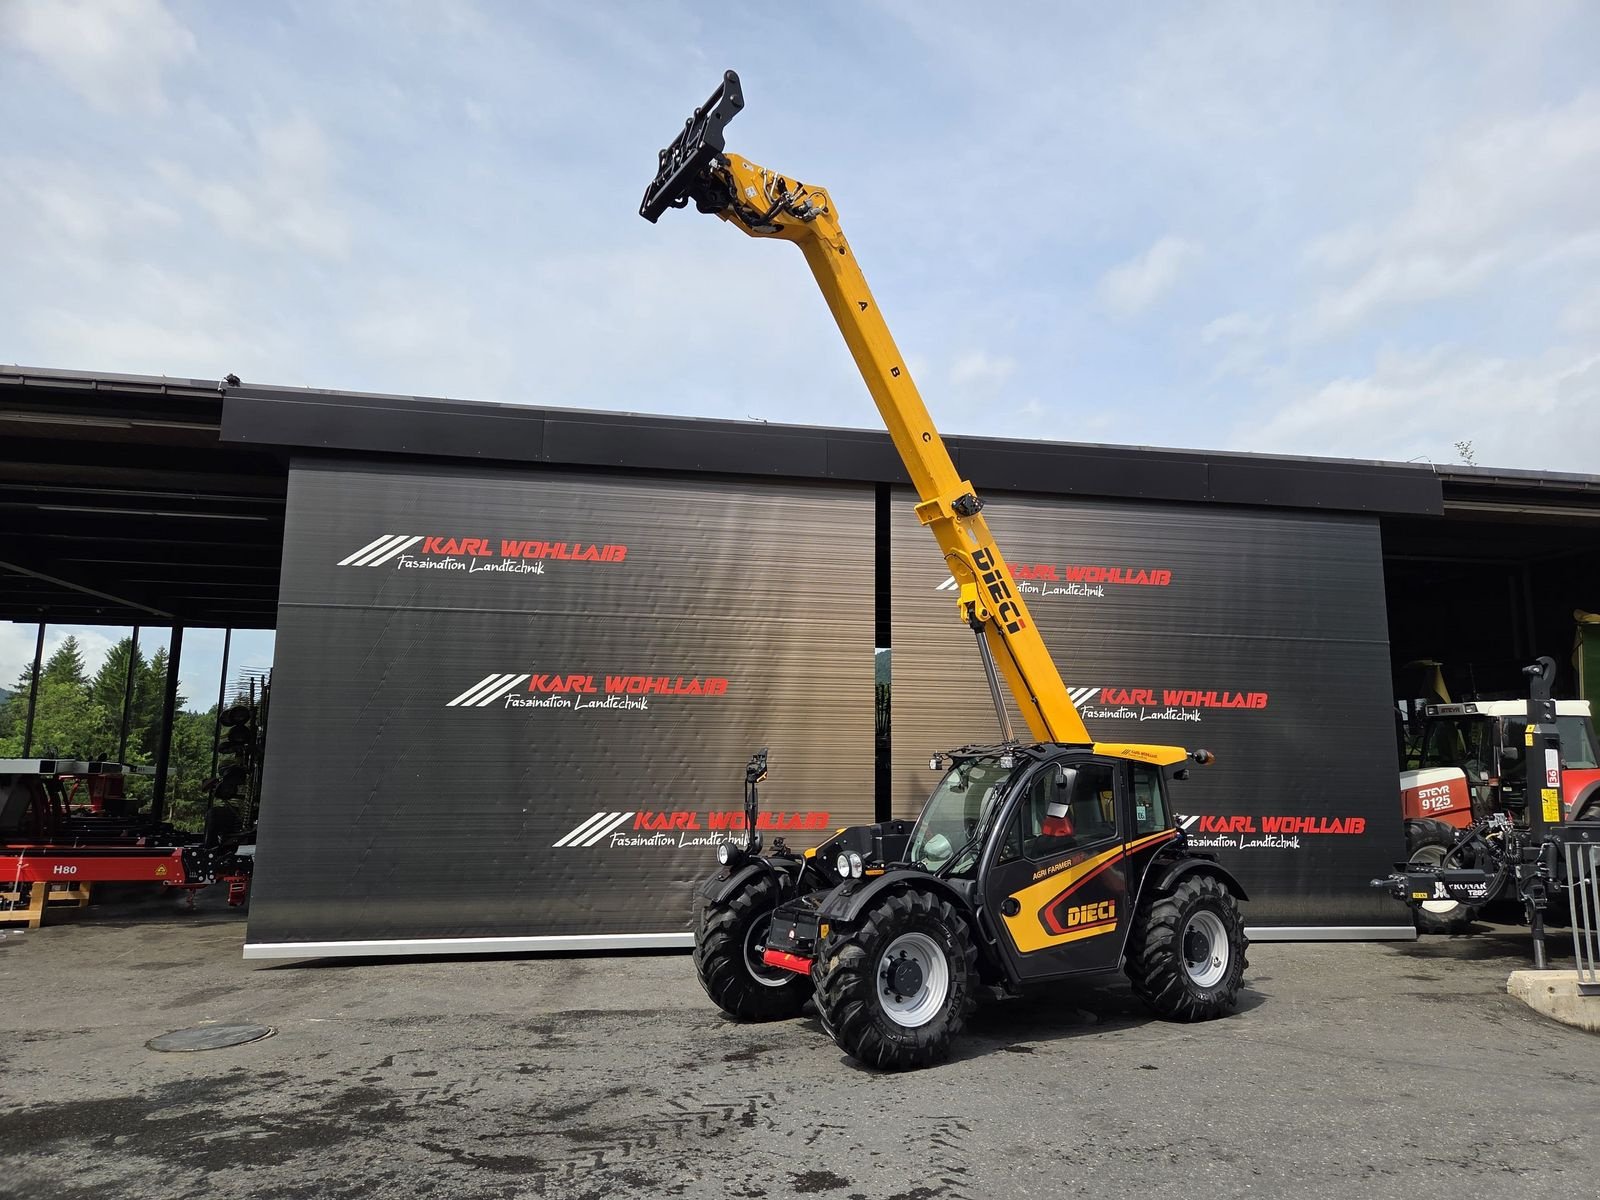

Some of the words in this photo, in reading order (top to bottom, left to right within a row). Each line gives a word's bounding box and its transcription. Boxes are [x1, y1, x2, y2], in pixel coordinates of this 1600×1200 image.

[858, 301, 868, 311] A
[891, 366, 900, 377] B
[922, 432, 931, 443] C
[423, 536, 493, 557] KARL
[500, 540, 627, 562] WOHLLAIB
[397, 554, 466, 571] Faszination
[468, 557, 544, 575] Landtechnik
[1006, 562, 1060, 581] KARL
[1066, 565, 1172, 585] WOHLLAIB
[1041, 581, 1105, 598] Landtechnik
[529, 674, 598, 693] KARL
[605, 676, 729, 697] WOHLLAIB
[504, 693, 571, 710] Faszination
[574, 694, 649, 712] Landtechnik
[1101, 687, 1157, 705] KARL
[1163, 690, 1268, 708] WOHLLAIB
[1080, 706, 1138, 720] Faszination
[1140, 707, 1202, 722] Landtechnik
[1548, 769, 1557, 783] 36
[1419, 785, 1450, 799] STEYR
[1422, 795, 1451, 810] 9125
[635, 811, 701, 828] KARL
[1199, 815, 1256, 832] KARL
[1262, 815, 1366, 834] WOHLLAIB
[609, 831, 675, 848] Faszination
[1239, 834, 1300, 850] Landtechnik
[53, 865, 77, 874] H80
[1032, 869, 1047, 881] AGRI
[1047, 859, 1072, 874] FARMER
